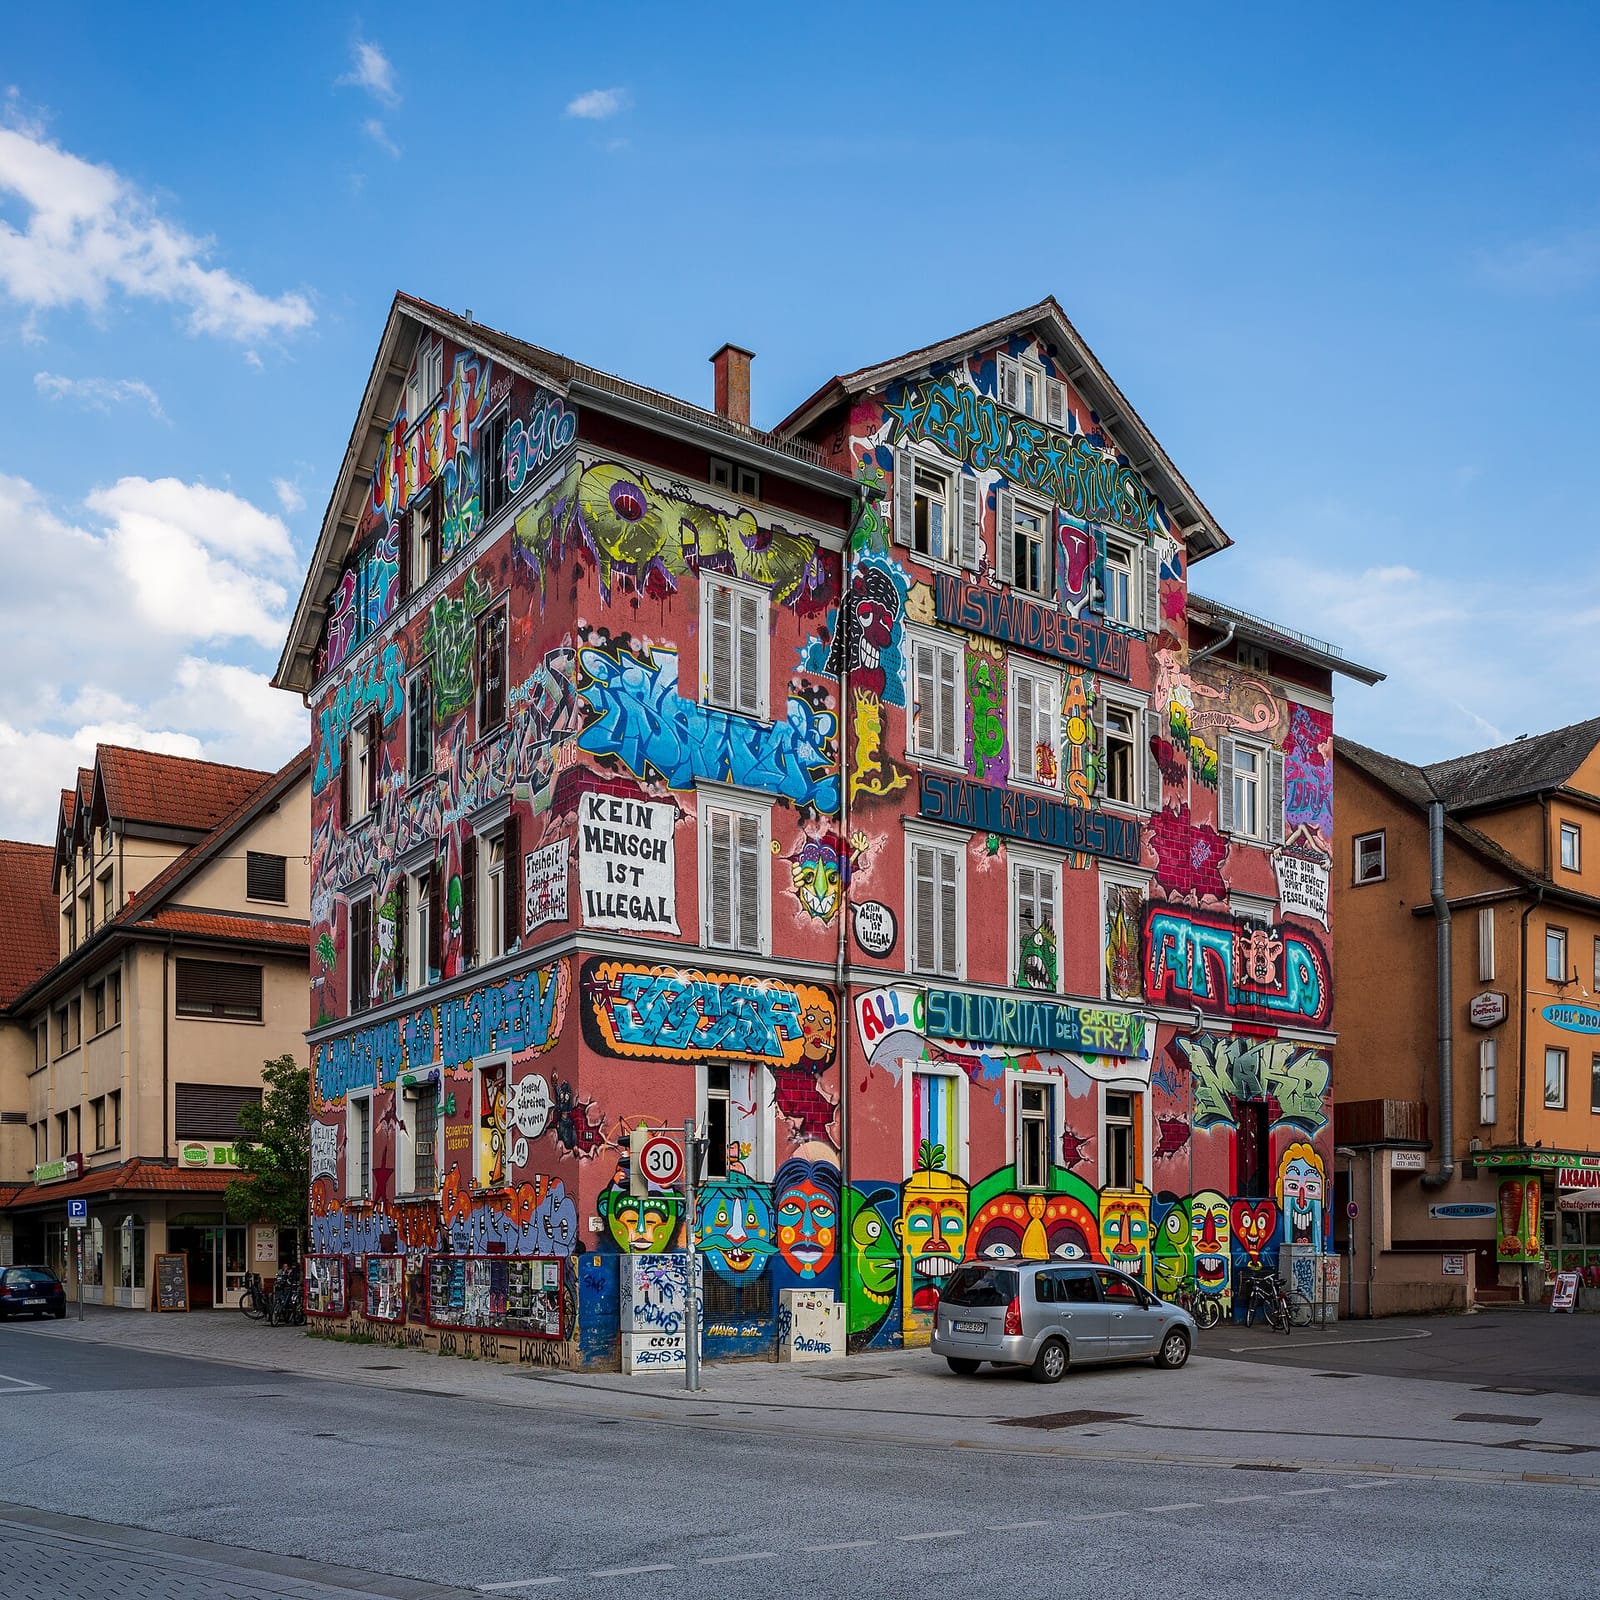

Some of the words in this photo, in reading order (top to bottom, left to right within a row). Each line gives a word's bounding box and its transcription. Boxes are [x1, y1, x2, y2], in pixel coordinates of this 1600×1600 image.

[939, 575, 1130, 676] INSTANDBESETZEN
[588, 797, 654, 830] KEIN
[924, 775, 993, 827] STATT
[583, 825, 668, 864] MENSCH
[606, 861, 645, 888] IST
[1284, 857, 1297, 870] WER
[1301, 861, 1315, 875] SICH
[585, 889, 672, 924] ILLEGAL
[1282, 890, 1308, 906] FESSELN
[1309, 898, 1327, 920] NICHT
[861, 990, 909, 1041] ALL
[928, 990, 1053, 1047] SOLIDARITÄT
[1055, 1005, 1079, 1022] MIT
[1078, 1009, 1131, 1029] GARTEN
[1056, 1022, 1080, 1041] DER
[649, 1150, 674, 1171] 30
[1396, 1152, 1421, 1161] EINGANG
[72, 1202, 82, 1216] P
